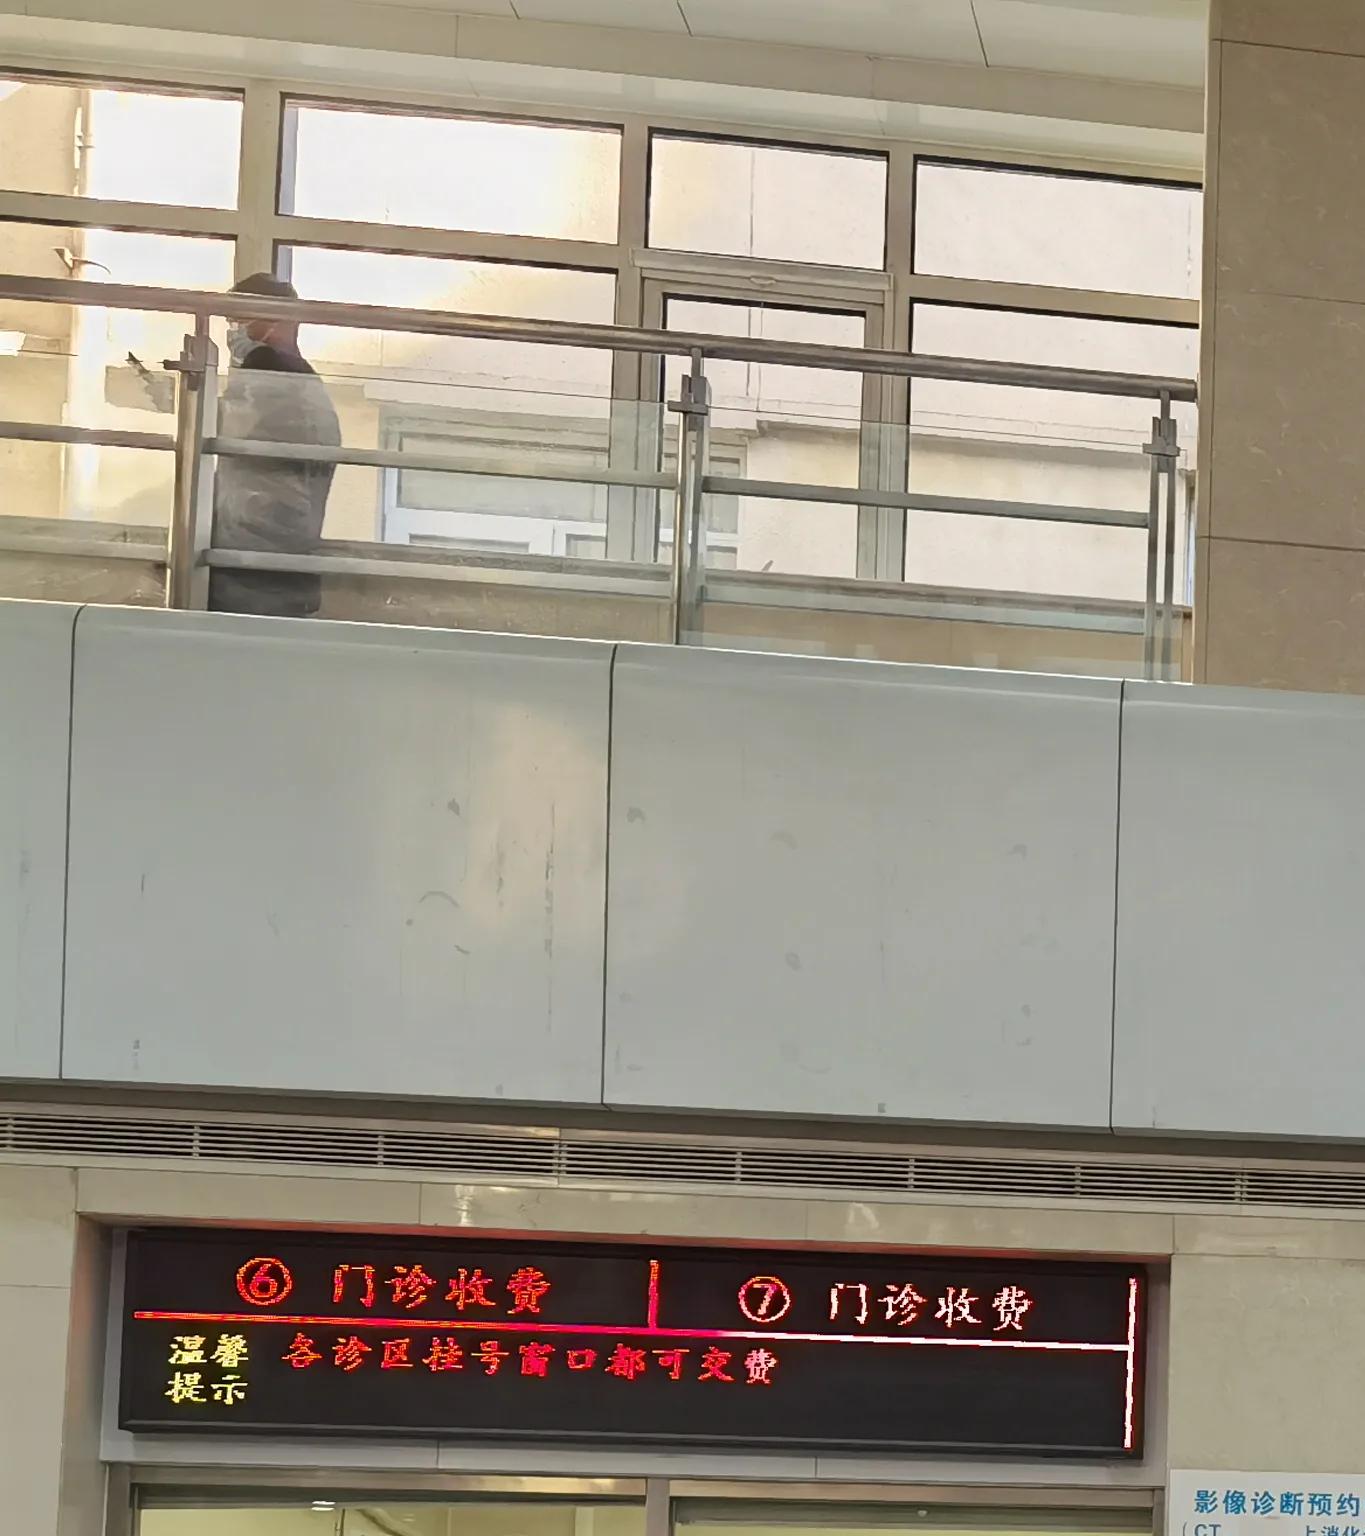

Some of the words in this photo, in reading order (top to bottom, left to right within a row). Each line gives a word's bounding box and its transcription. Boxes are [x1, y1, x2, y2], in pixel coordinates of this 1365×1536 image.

[333, 1264, 551, 1314] 门诊收费
[830, 1283, 1034, 1332] 门诊收费
[168, 1333, 249, 1367] 温馨
[282, 1333, 777, 1384] 各诊区挂号窗口都可交费
[165, 1371, 248, 1404] 提示
